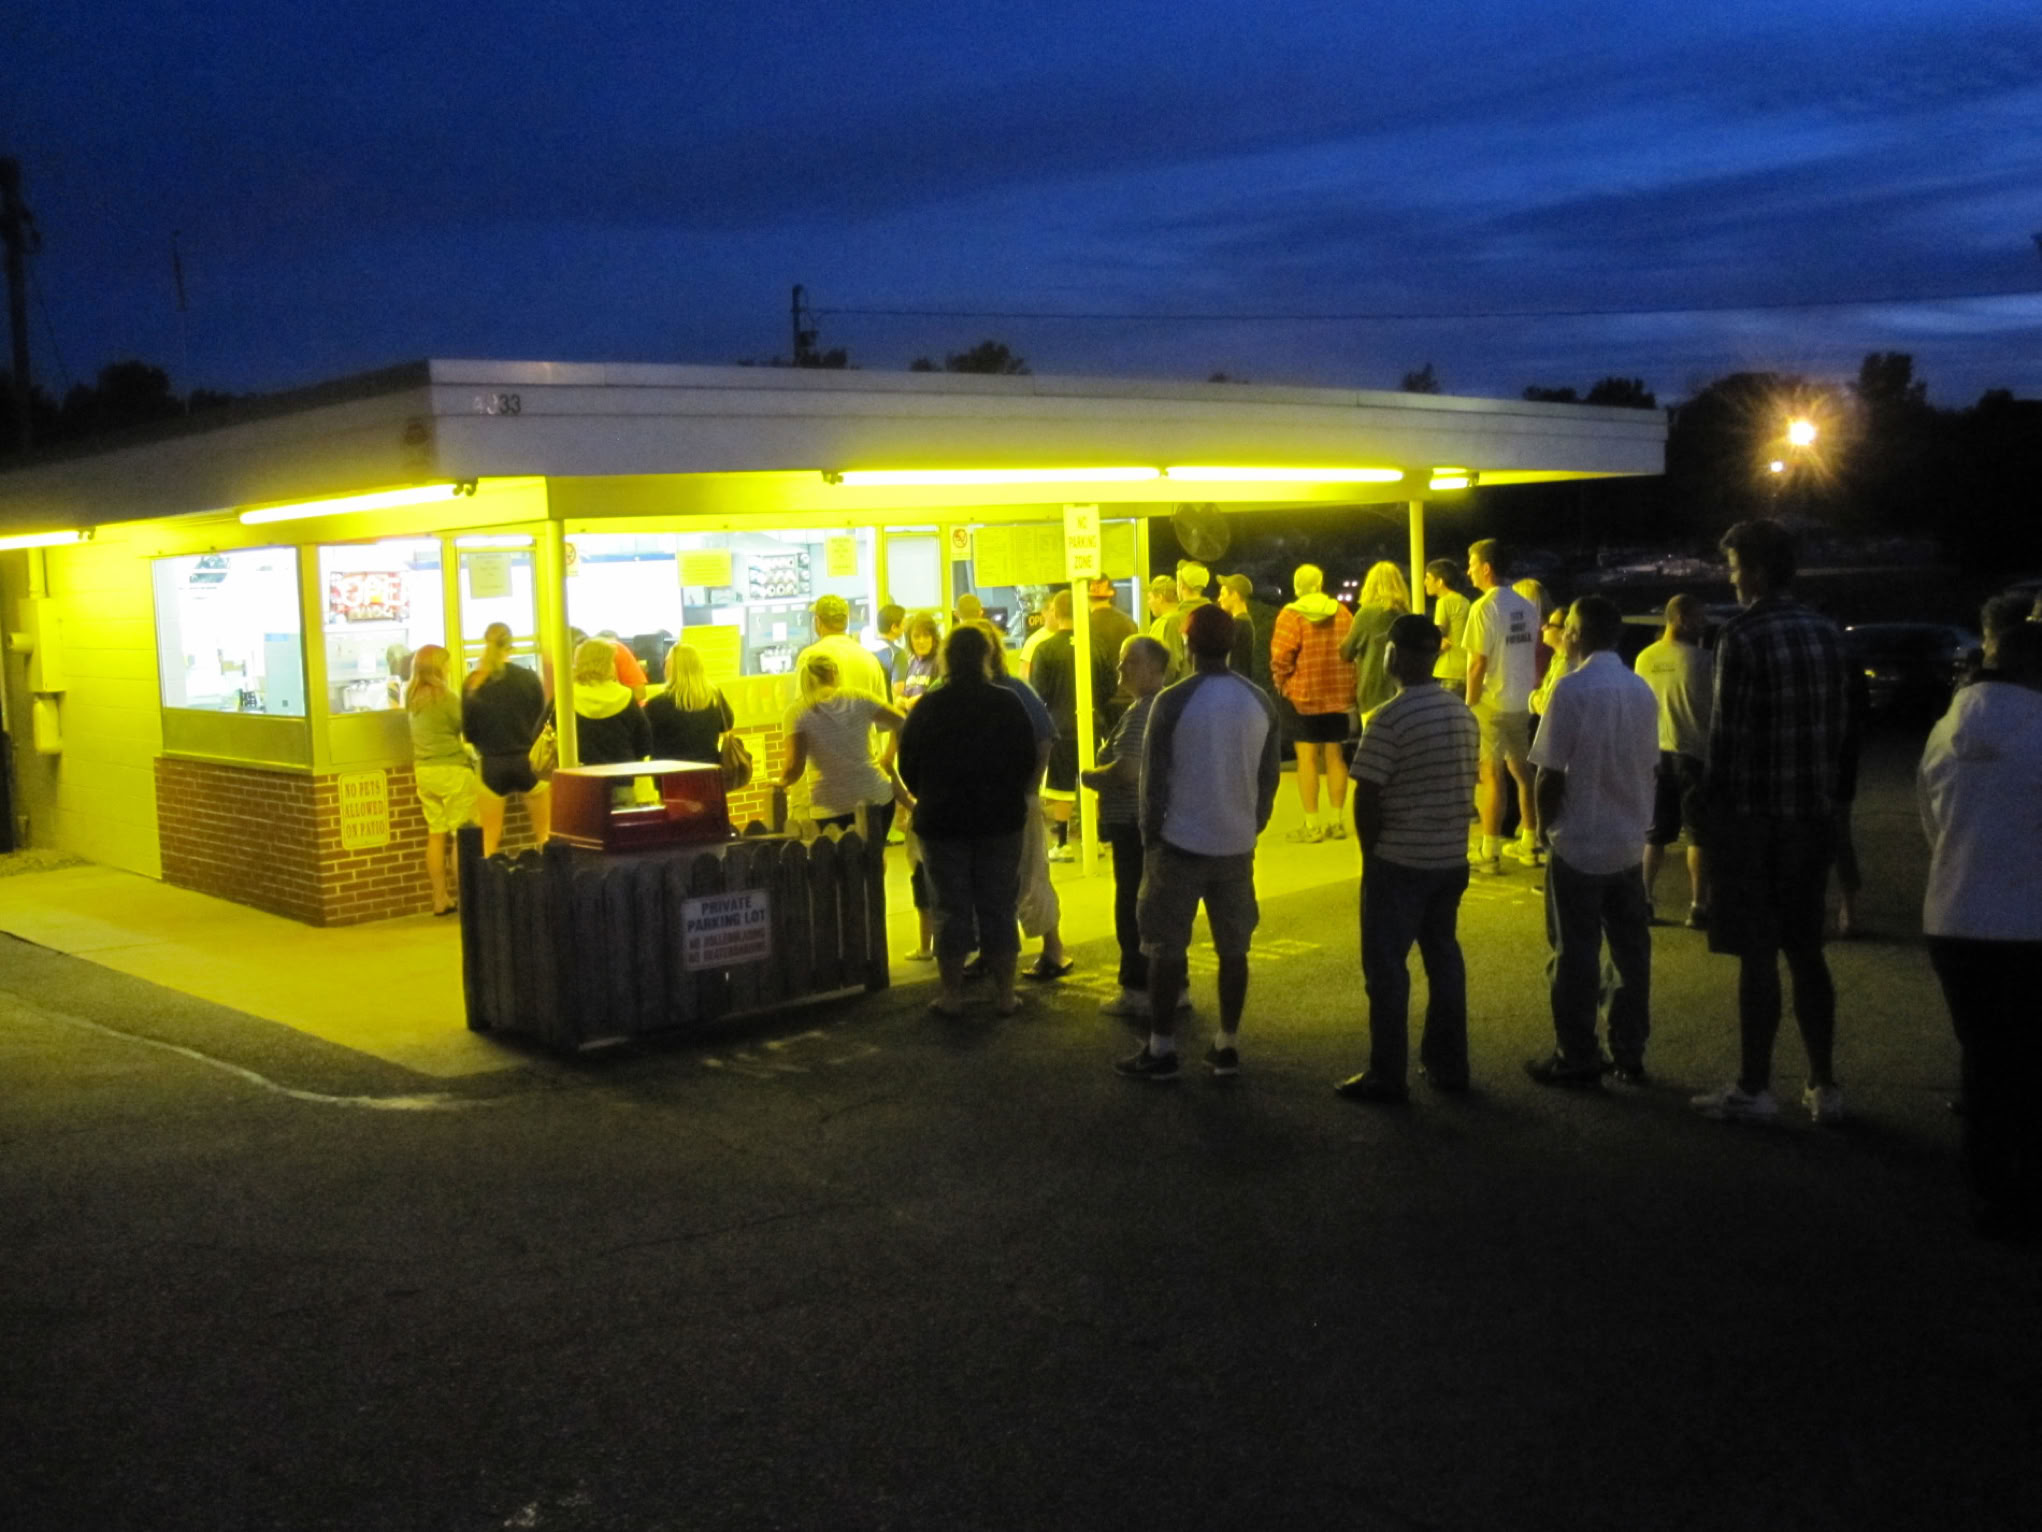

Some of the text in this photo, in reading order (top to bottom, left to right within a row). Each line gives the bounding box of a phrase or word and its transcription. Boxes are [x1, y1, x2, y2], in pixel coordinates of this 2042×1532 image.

[1077, 516, 1087, 529] NO
[1068, 535, 1096, 549] PARKING
[1074, 555, 1092, 569] ZONE
[345, 779, 381, 799] NO PETS
[345, 800, 384, 818] ALLOWED
[346, 820, 385, 839] ON PATIO
[702, 896, 752, 916] PRIVATE
[687, 908, 765, 933] PARKING LOT
